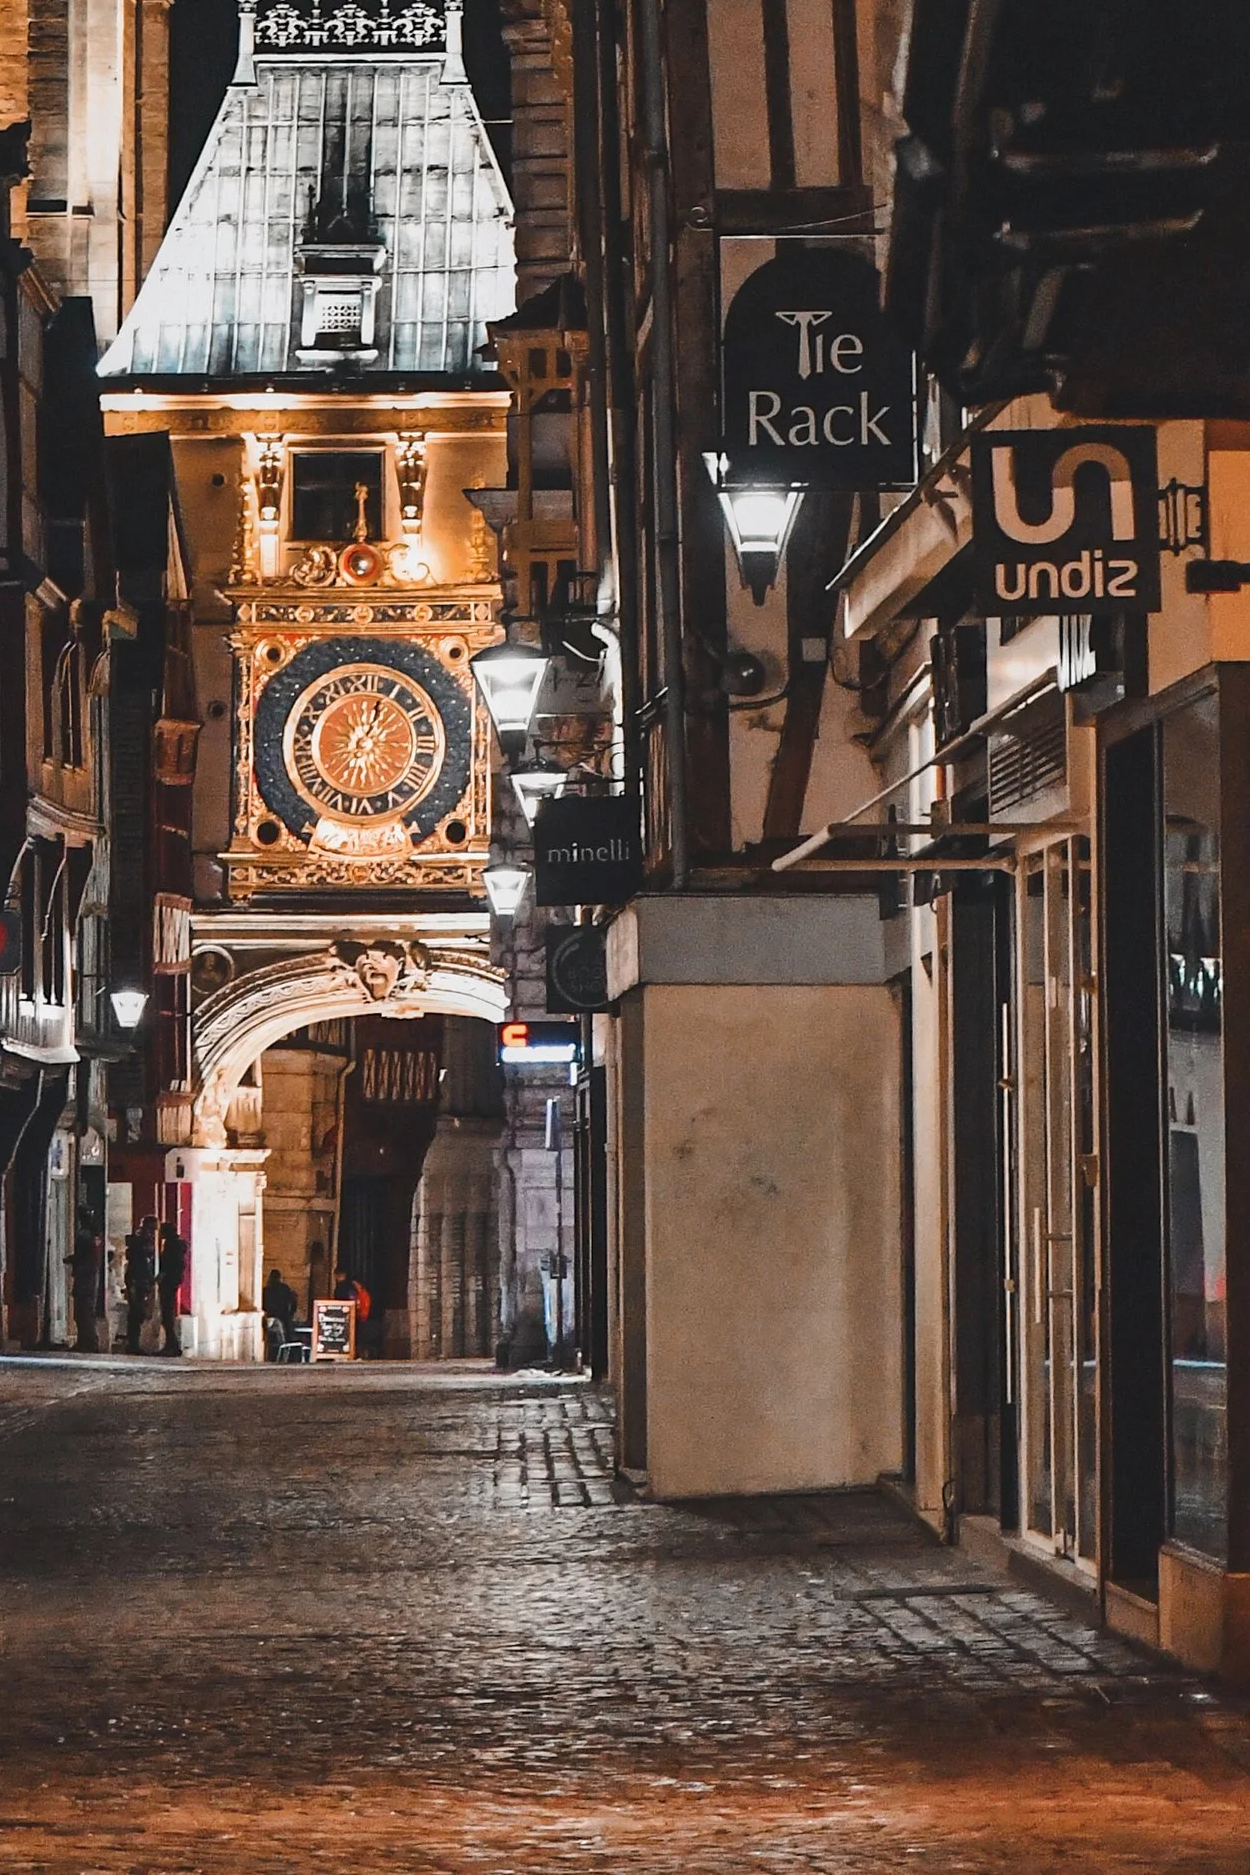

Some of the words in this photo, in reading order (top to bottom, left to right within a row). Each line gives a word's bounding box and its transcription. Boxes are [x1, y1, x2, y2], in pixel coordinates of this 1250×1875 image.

[775, 311, 863, 380] Tie
[747, 390, 892, 446] Rack
[995, 549, 1138, 602] undiz
[547, 839, 630, 863] minelli
